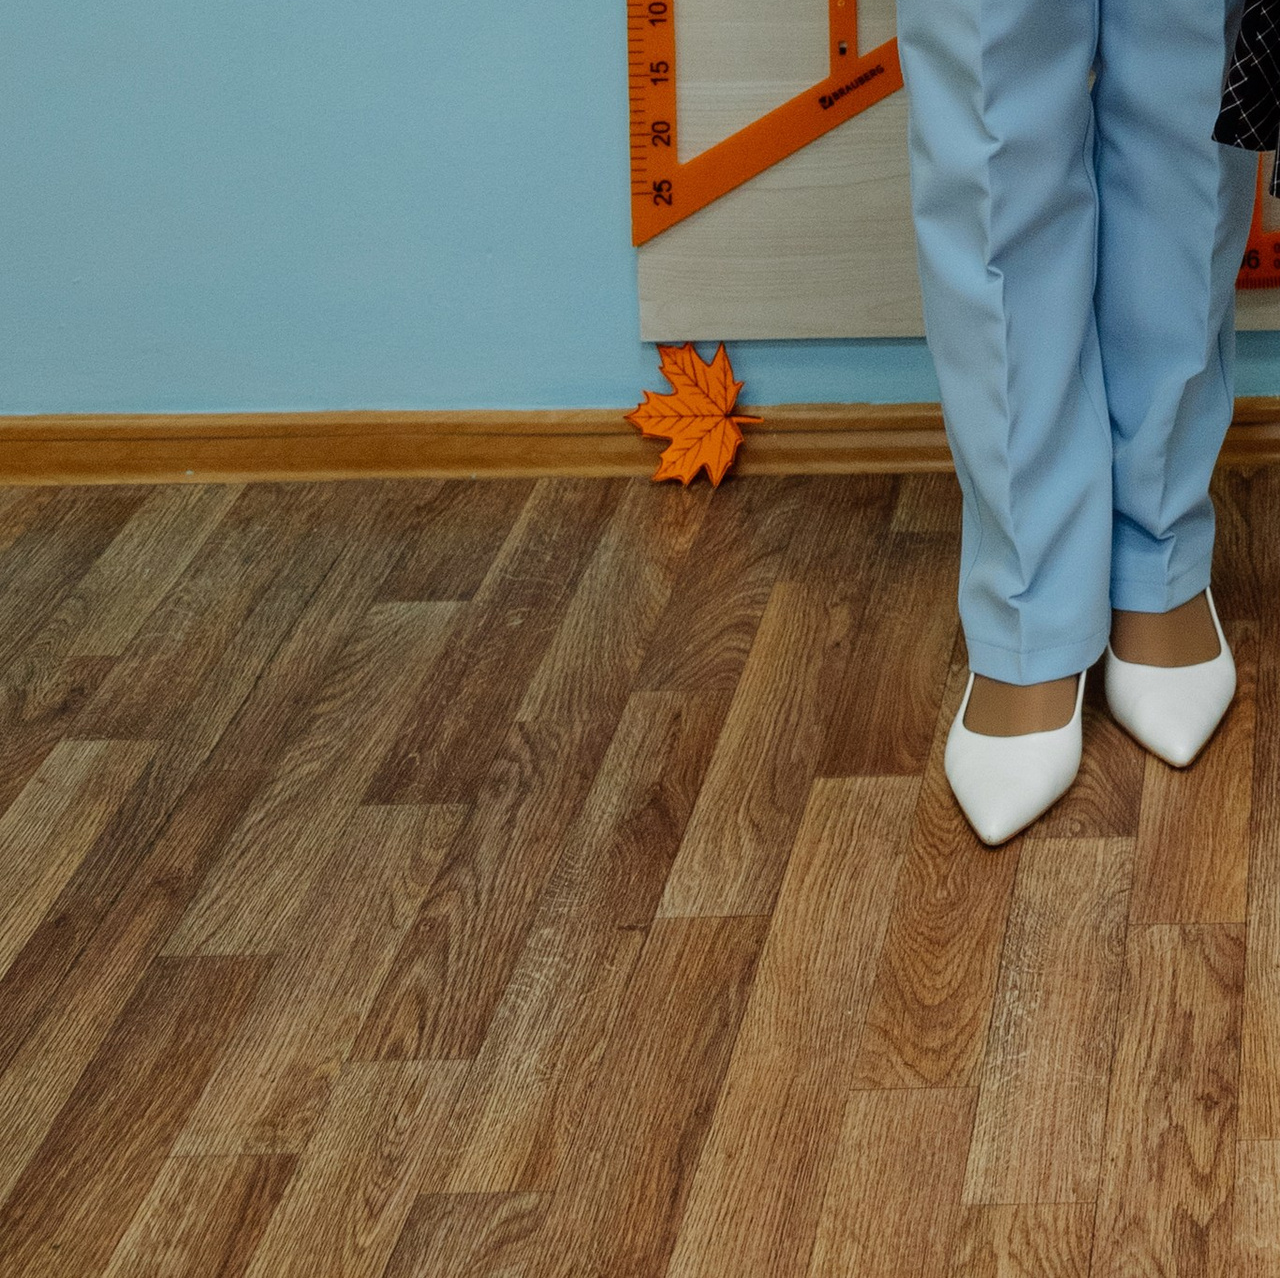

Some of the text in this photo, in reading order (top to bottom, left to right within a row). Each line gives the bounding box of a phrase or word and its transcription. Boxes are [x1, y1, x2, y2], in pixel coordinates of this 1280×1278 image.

[649, 1, 668, 27] 10
[650, 60, 669, 86] 15
[831, 64, 885, 101] BRAUBERG
[651, 120, 672, 147] 20
[653, 179, 673, 206] 25
